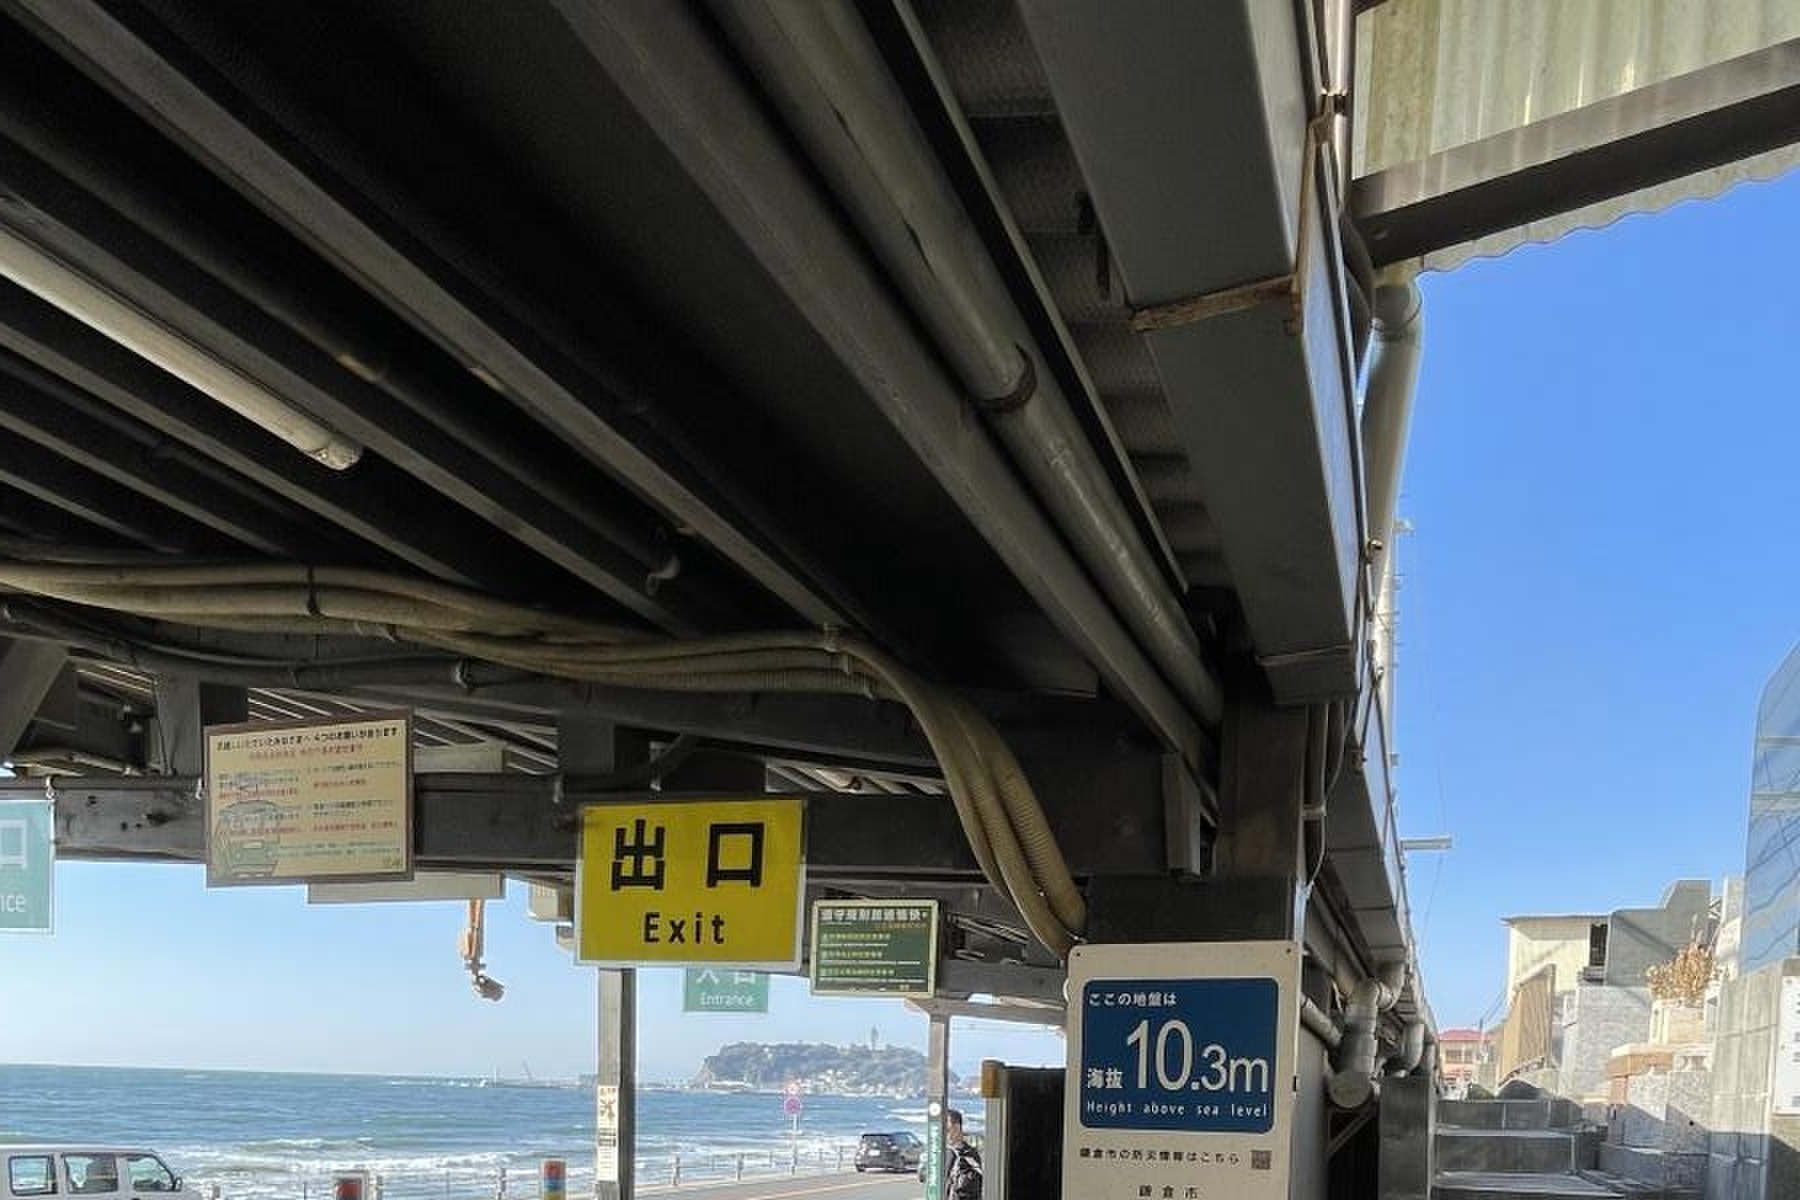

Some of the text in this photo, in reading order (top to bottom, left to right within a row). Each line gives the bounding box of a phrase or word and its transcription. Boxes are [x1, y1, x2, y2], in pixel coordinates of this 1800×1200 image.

[611, 819, 765, 891] 出口
[643, 911, 725, 944] Exit
[700, 991, 758, 1006] Entrance
[1088, 991, 1178, 1007] ここの地盤は
[1087, 1018, 1270, 1094] 海抜 10.3m
[1086, 1100, 1268, 1118] Height above sea level
